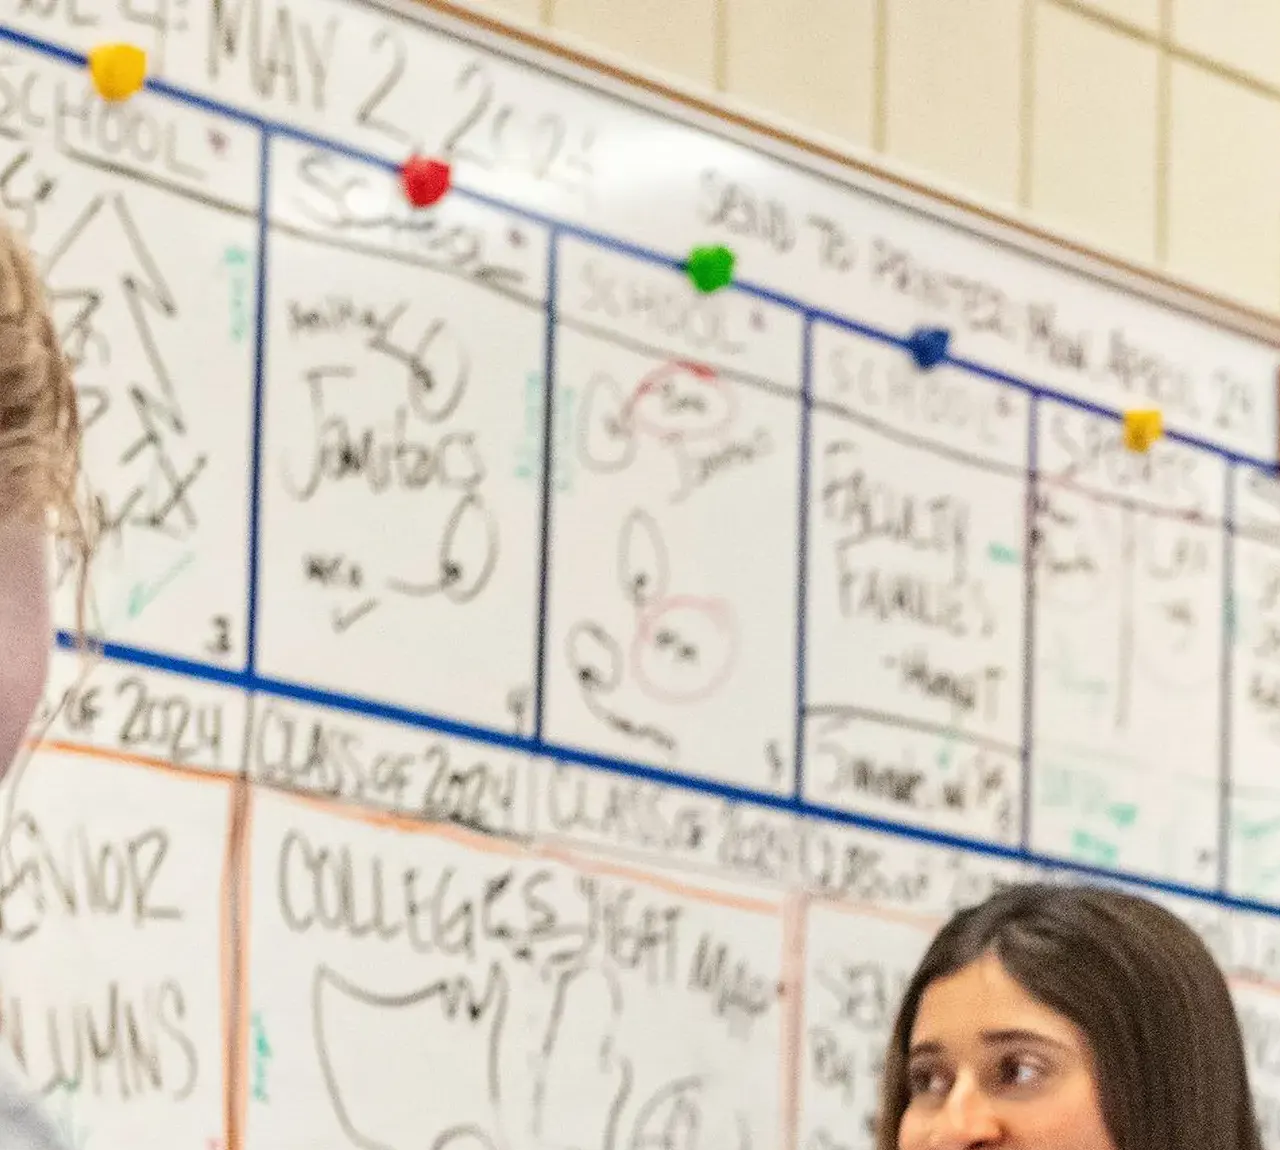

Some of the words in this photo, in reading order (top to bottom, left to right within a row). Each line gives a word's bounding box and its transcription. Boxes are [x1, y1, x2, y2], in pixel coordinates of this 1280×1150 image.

[206, 0, 342, 108] MAY
[806, 213, 858, 272] TO
[828, 345, 1002, 446] SCHOOL
[115, 676, 226, 762] 2024
[0, 810, 184, 942] ENIOR
[8, 978, 200, 1102] LUMNS
